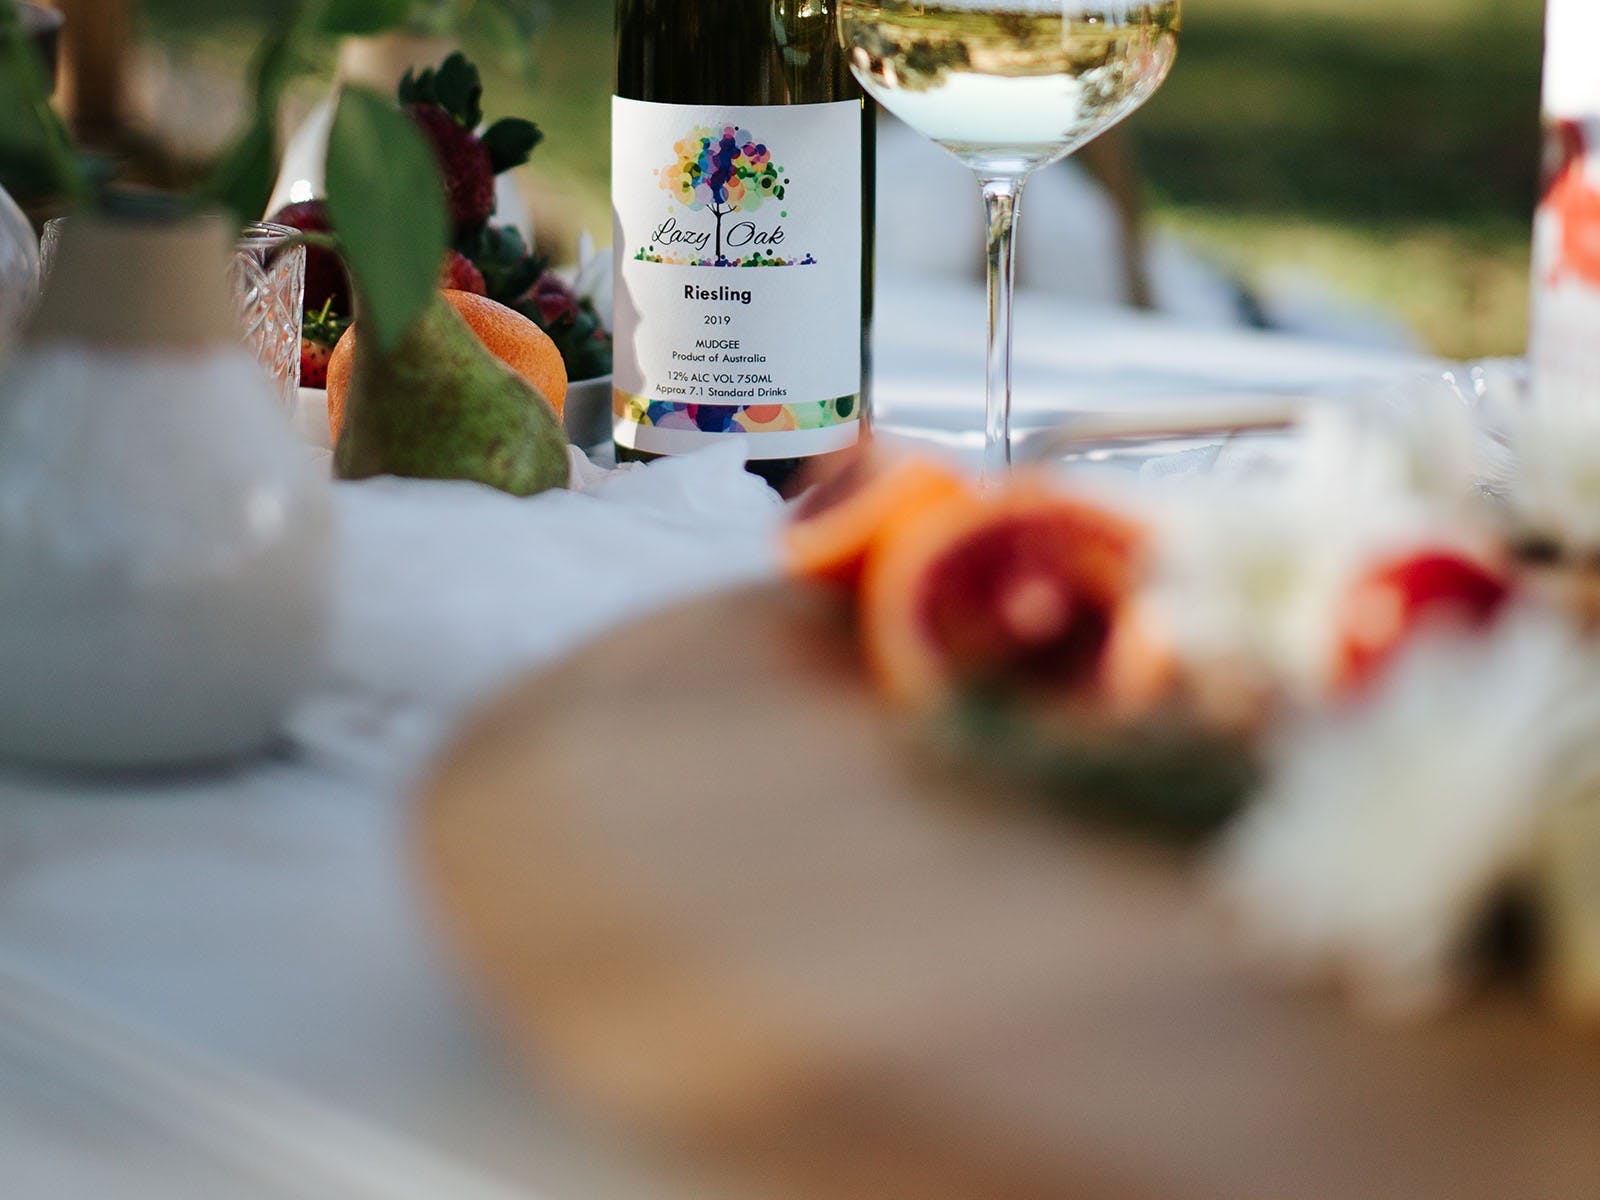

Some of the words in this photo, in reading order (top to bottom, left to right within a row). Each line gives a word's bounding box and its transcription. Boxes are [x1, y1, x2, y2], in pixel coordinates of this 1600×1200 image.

[652, 217, 711, 250] Lazy
[727, 221, 785, 247] Oak
[684, 285, 752, 304] Riesling
[704, 315, 731, 325] 2019
[695, 339, 740, 349] MUDGEE
[672, 351, 706, 362] Product
[708, 353, 719, 362] of
[722, 353, 766, 363] Australia
[667, 370, 689, 382] 12%
[690, 373, 710, 383] ALC
[713, 374, 734, 384] VOL
[737, 374, 773, 384] 750ML
[655, 384, 686, 395] Approx
[689, 386, 703, 396] 7.1
[708, 387, 754, 397] Standard
[757, 387, 787, 397] Drinks
